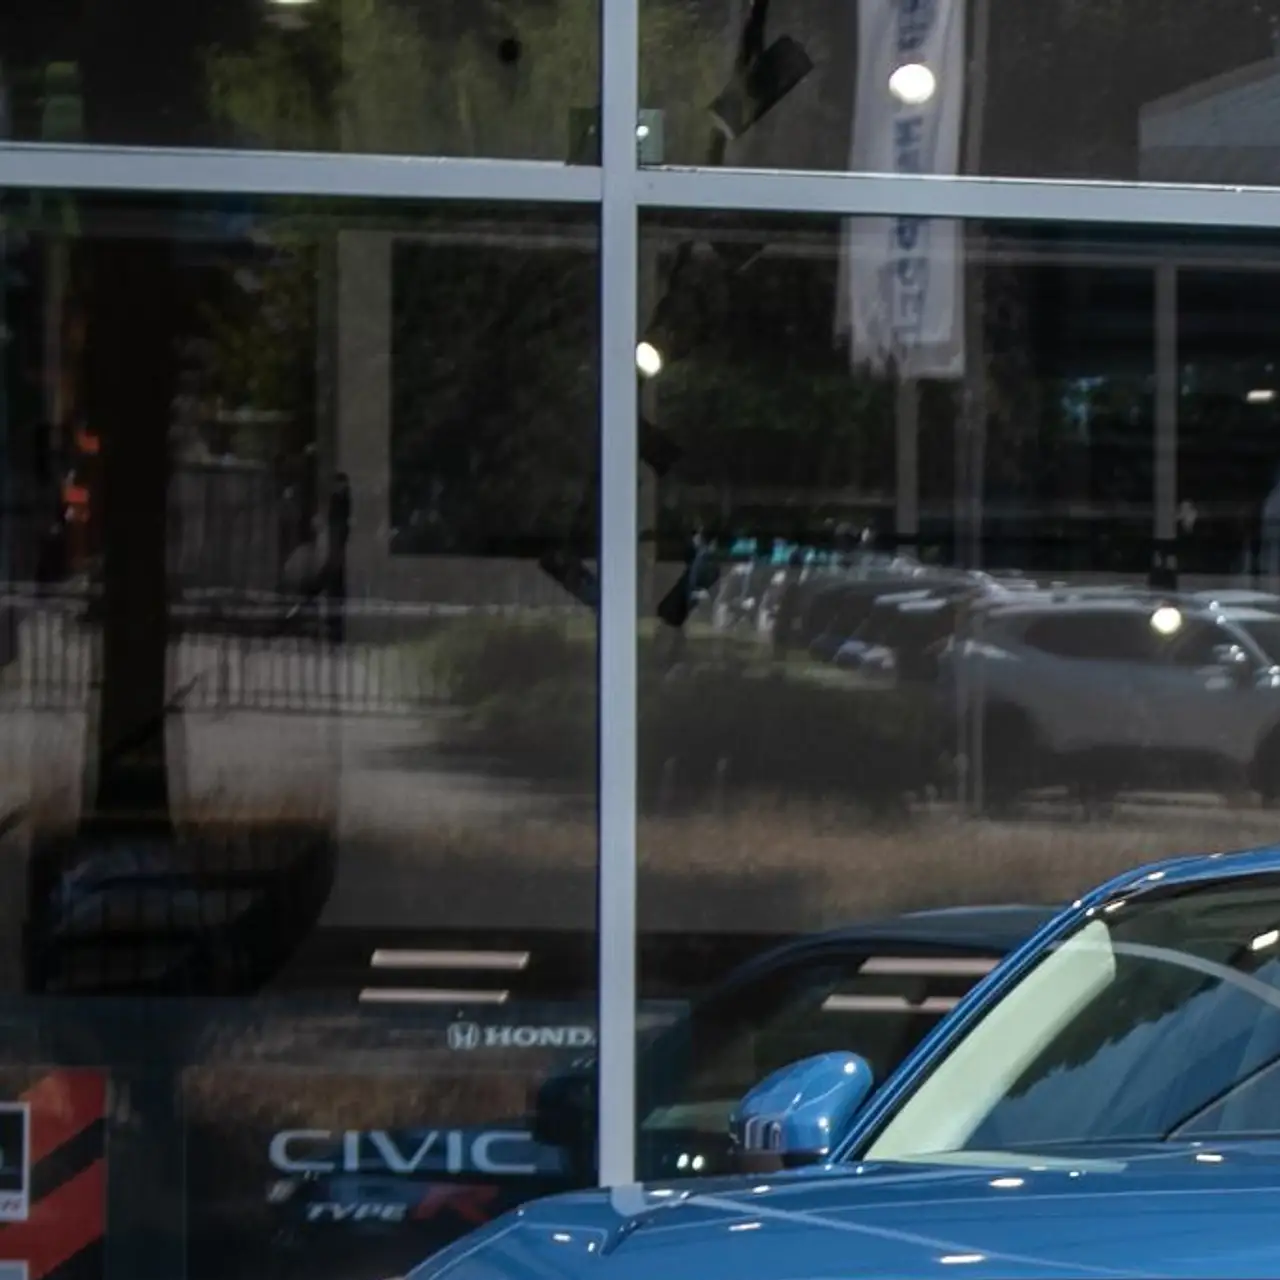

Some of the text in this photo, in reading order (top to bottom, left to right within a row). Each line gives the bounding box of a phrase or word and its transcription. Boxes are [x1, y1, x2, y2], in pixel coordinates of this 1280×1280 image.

[484, 1024, 597, 1047] HOND
[268, 1129, 536, 1173] CIVIC
[306, 1202, 407, 1221] TYPE
